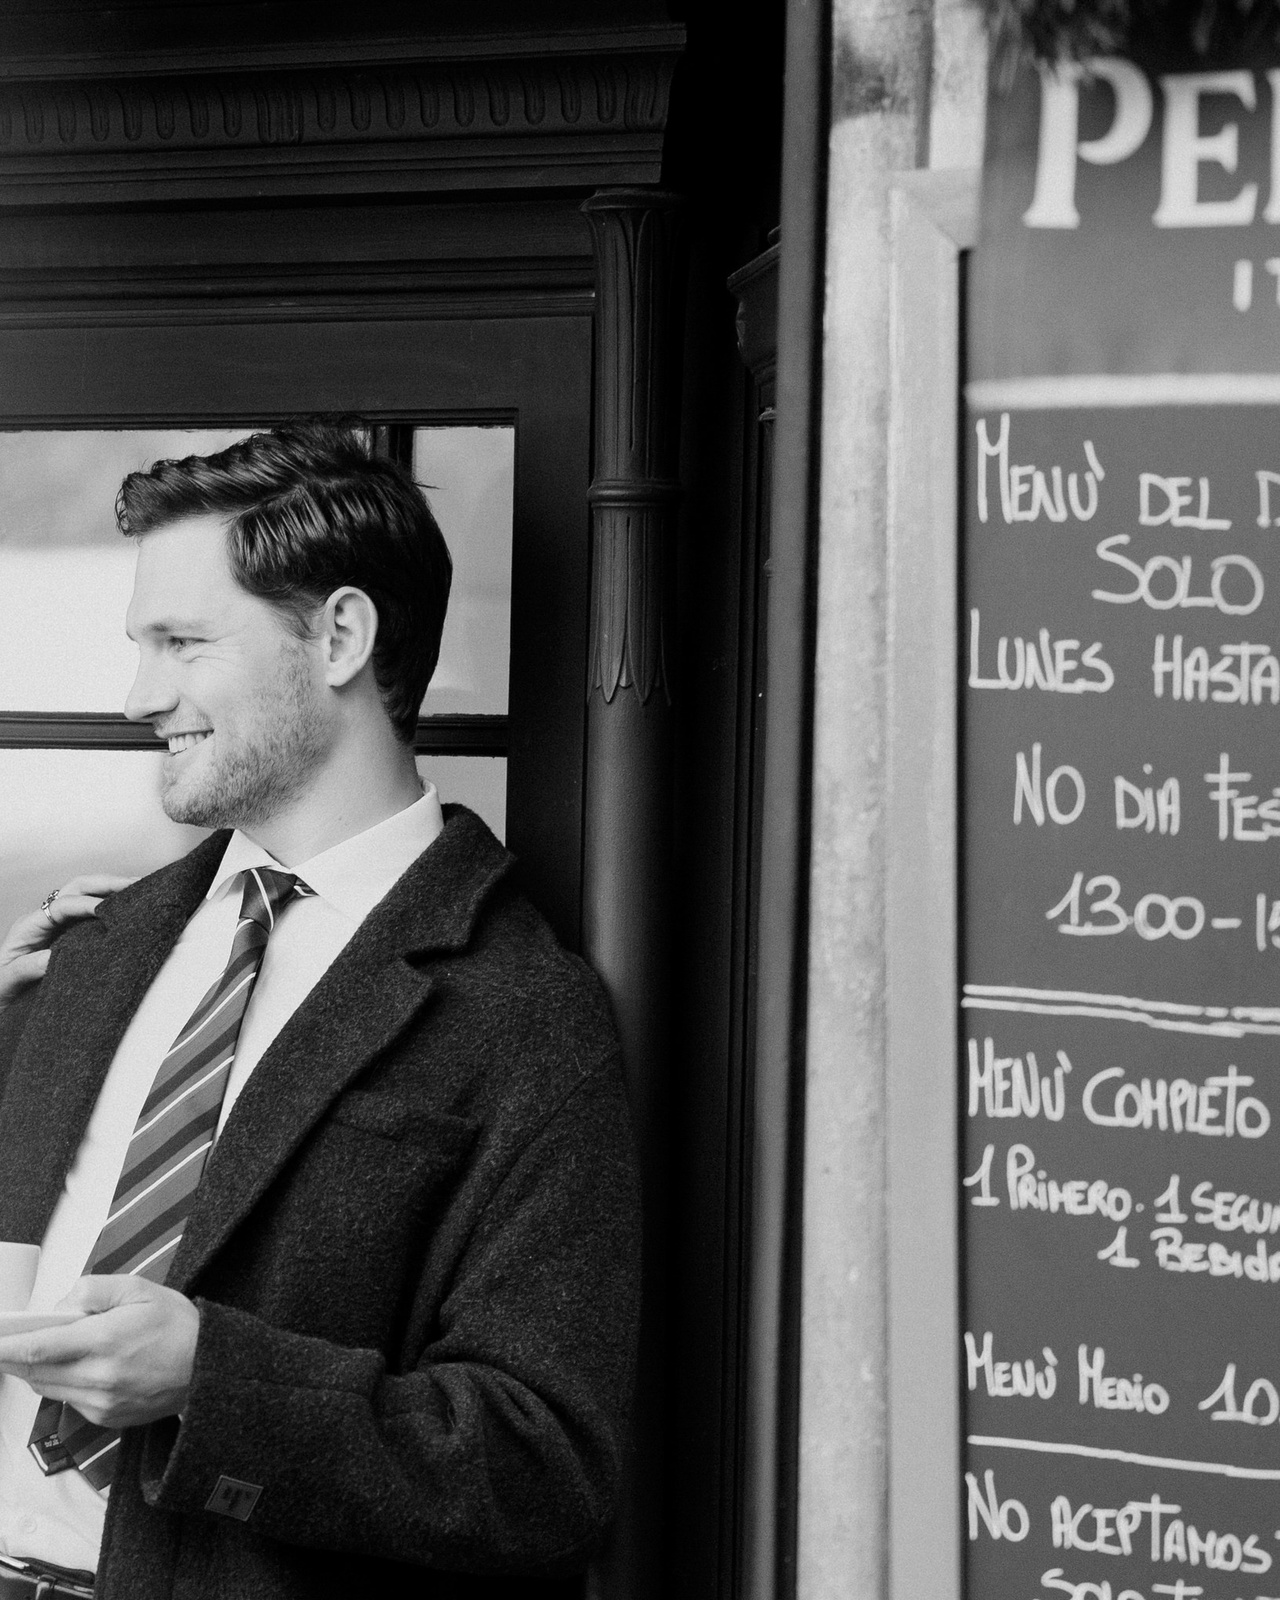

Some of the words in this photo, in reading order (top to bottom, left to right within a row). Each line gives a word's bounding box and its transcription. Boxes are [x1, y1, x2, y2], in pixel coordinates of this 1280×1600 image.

[1022, 56, 1280, 229] PE
[1138, 472, 1232, 531] DEL
[1091, 533, 1265, 616] SOLO
[968, 608, 1115, 694] LUNES
[1151, 634, 1280, 705] HASTA
[1013, 742, 1086, 827] NO
[1081, 1065, 1271, 1139] COMPLETO
[963, 1142, 1002, 1208] 1
[1153, 1174, 1188, 1224] 1
[1097, 1225, 1140, 1269] 1
[964, 1468, 1031, 1543] NO
[1048, 1493, 1273, 1576] ACEPTAMOS
